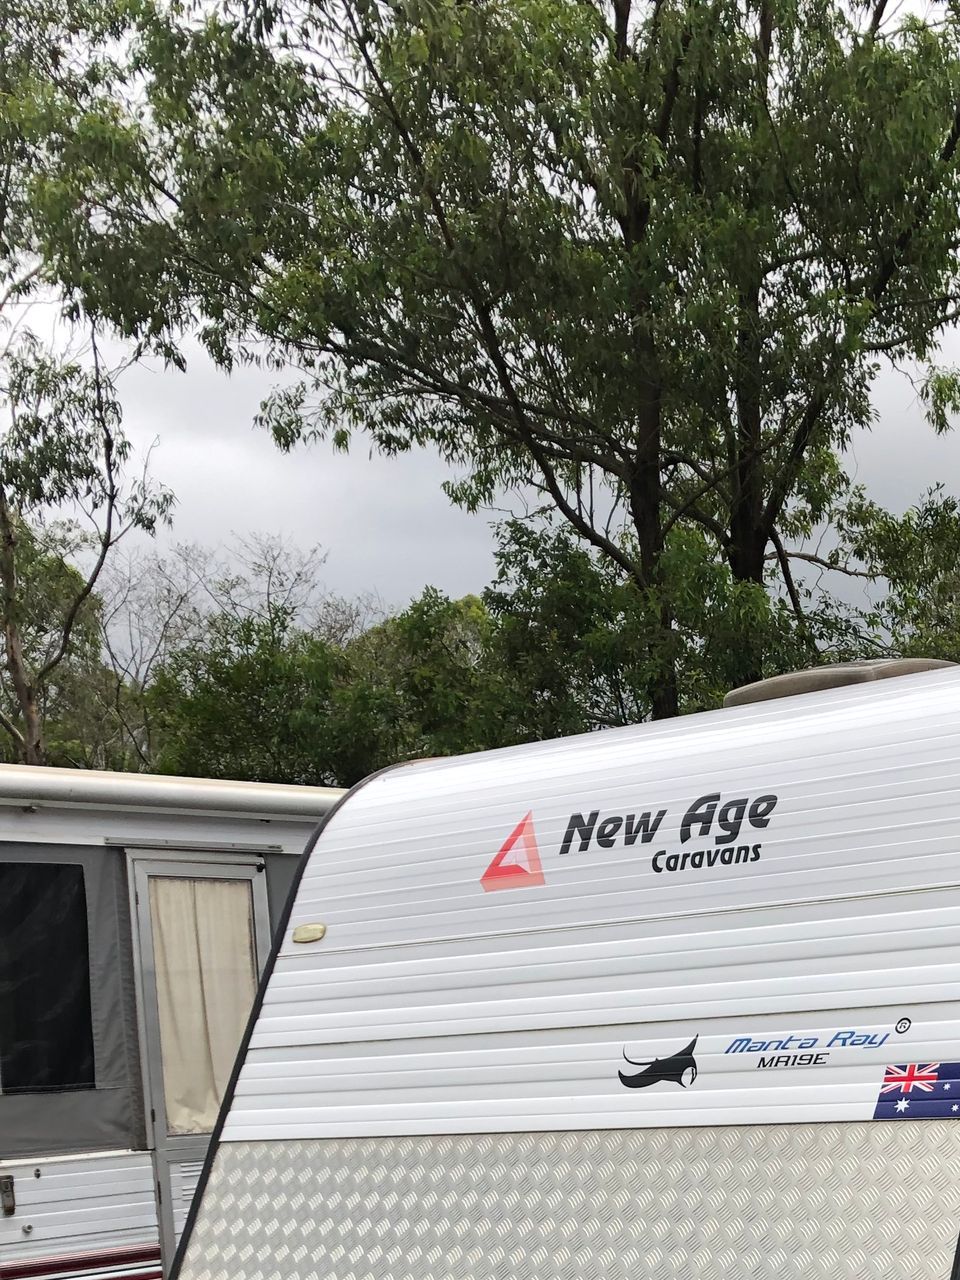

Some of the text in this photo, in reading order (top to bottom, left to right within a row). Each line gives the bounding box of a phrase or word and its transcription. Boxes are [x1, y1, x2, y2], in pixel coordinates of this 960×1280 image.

[559, 791, 778, 855] New Age
[651, 843, 762, 873] Caravans
[724, 1035, 819, 1055] Manta
[826, 1030, 890, 1049] Ray
